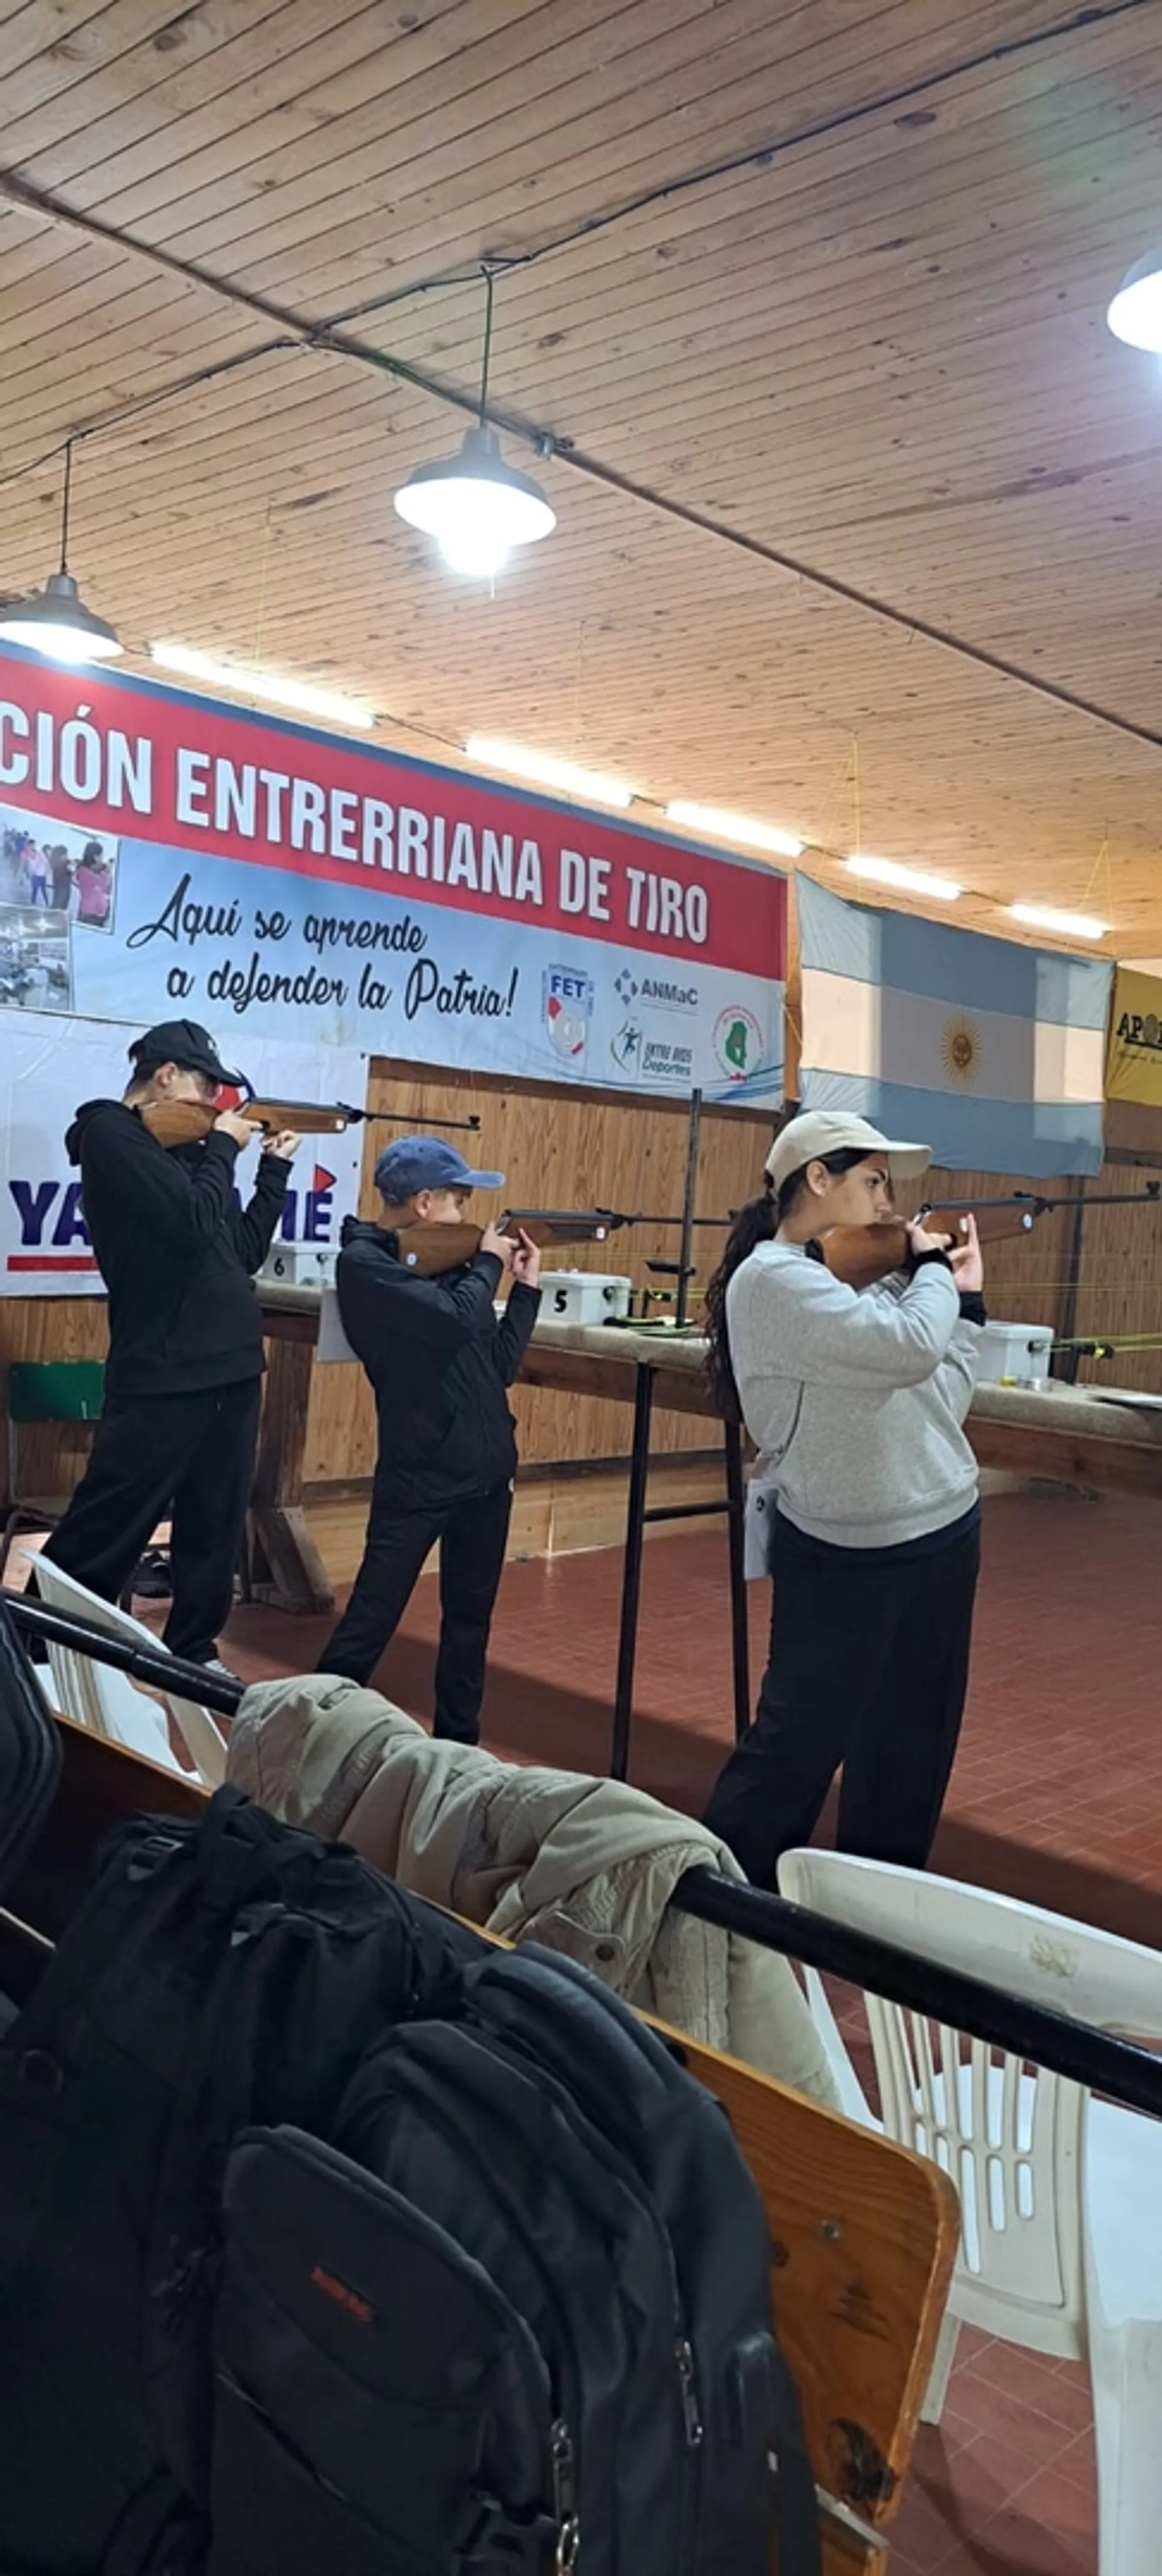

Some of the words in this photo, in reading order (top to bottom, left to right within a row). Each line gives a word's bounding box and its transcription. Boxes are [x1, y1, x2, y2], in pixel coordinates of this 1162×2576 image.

[176, 748, 543, 905] ENTRERRIANA
[559, 849, 611, 921] DE
[626, 867, 708, 944] TIRO
[254, 909, 292, 941] se
[303, 915, 428, 954] aprende
[166, 967, 195, 998] a
[207, 952, 349, 1014] defender
[357, 963, 393, 1010] la
[404, 958, 519, 1020] Patria!
[551, 975, 585, 998] FET
[641, 978, 698, 1005] ANMaC
[274, 1257, 285, 1277] 6
[554, 1290, 567, 1312] 5
